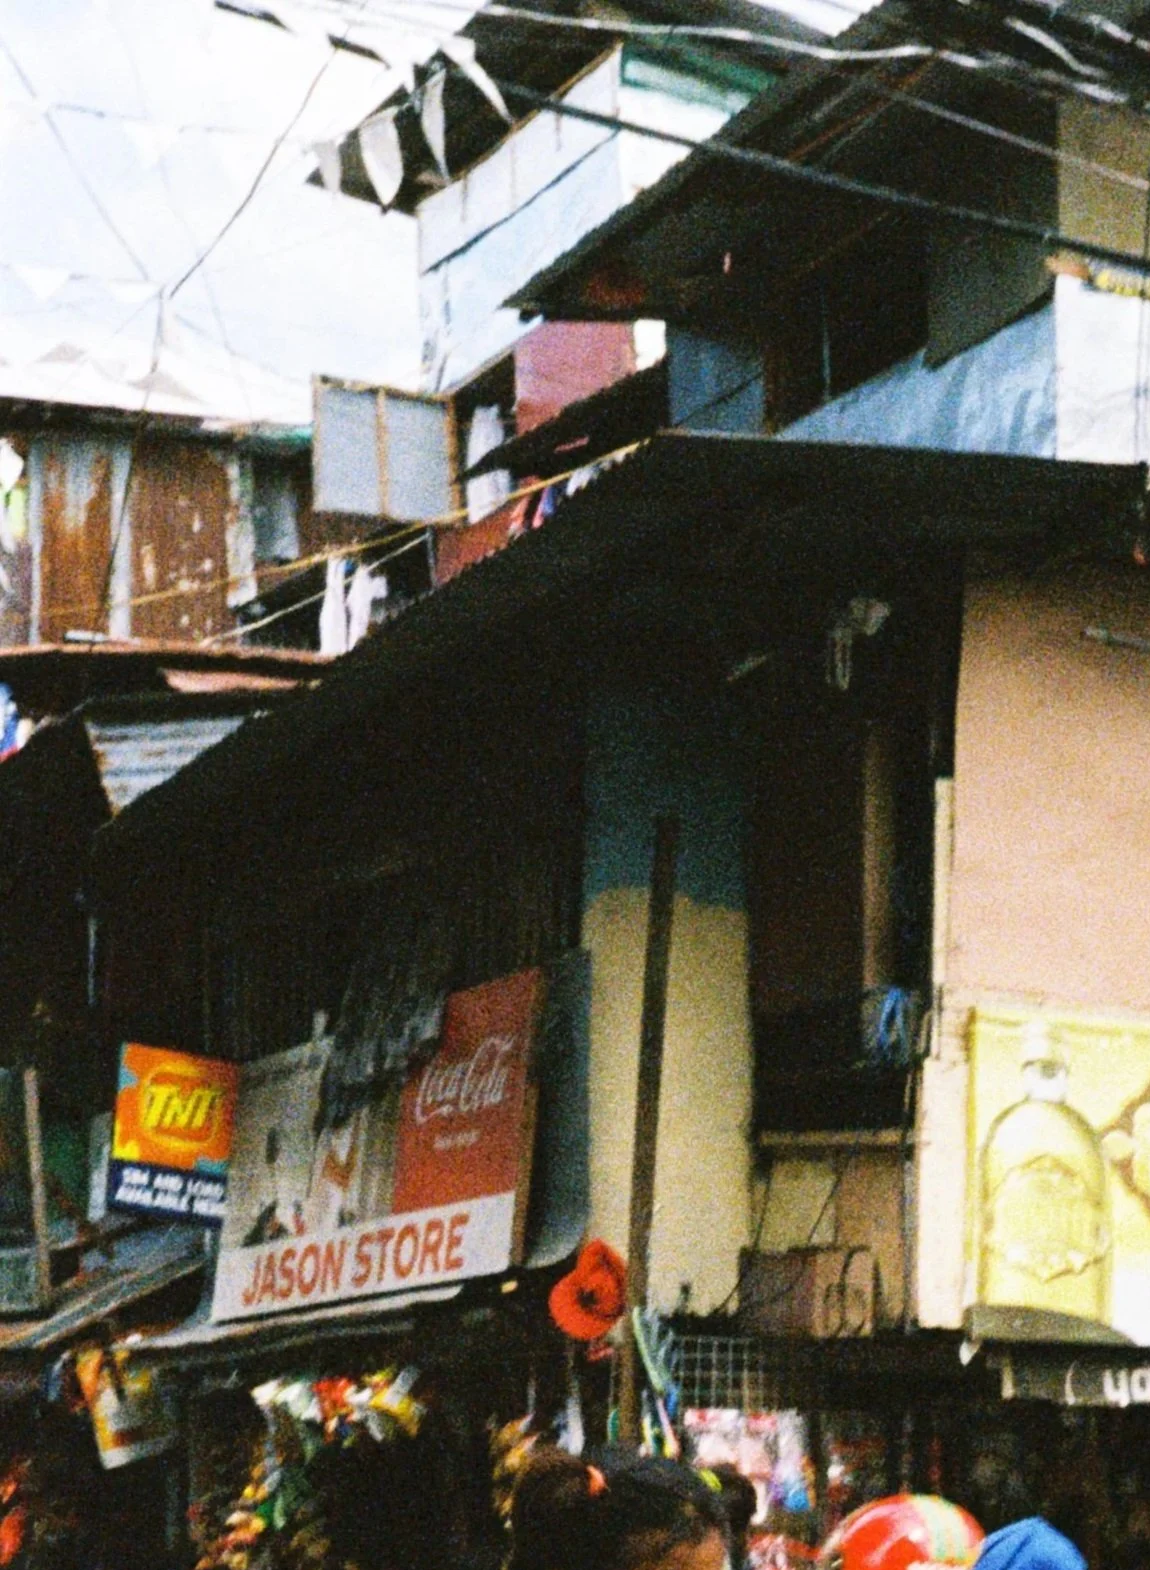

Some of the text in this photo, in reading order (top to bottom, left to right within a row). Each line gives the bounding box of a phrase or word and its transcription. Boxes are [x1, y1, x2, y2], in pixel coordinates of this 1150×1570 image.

[143, 1083, 222, 1130] TNT
[242, 1213, 470, 1308] JASON STORE
